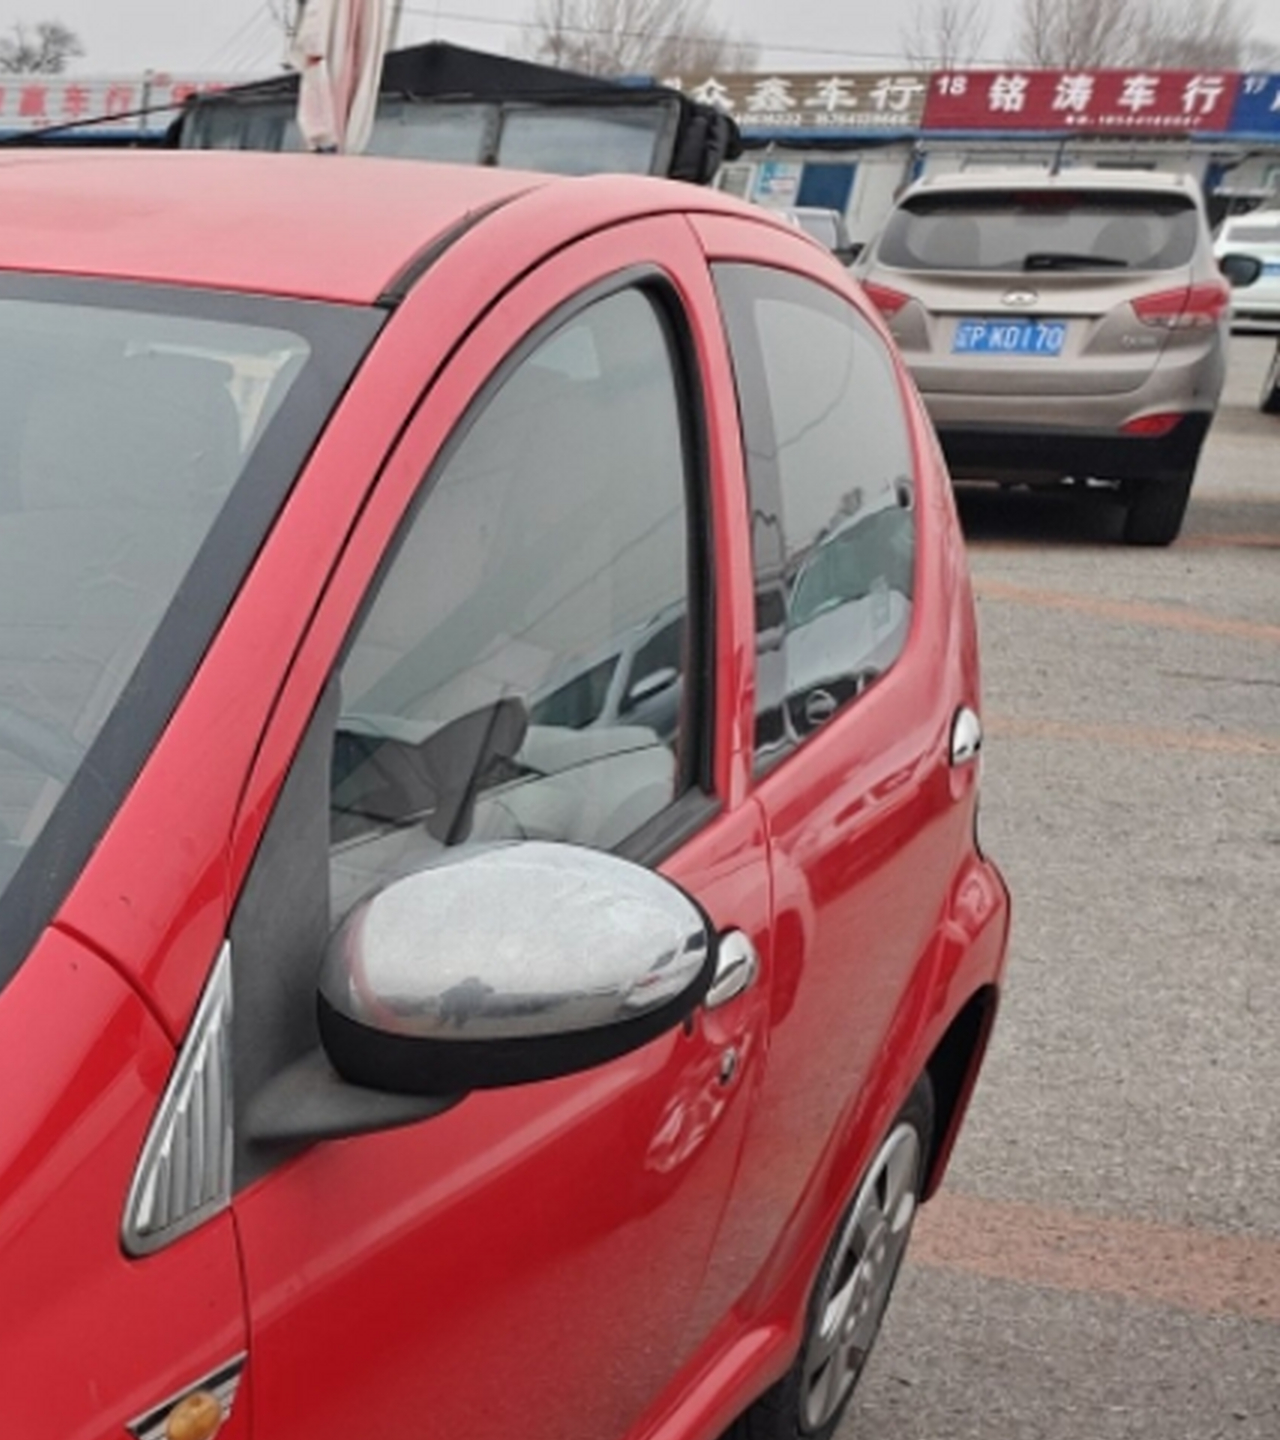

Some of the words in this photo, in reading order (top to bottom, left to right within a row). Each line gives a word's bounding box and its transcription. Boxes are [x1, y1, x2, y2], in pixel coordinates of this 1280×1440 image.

[693, 76, 924, 112] 众鑫车行
[937, 76, 966, 95] 18
[989, 75, 1223, 114] 铭涛车行
